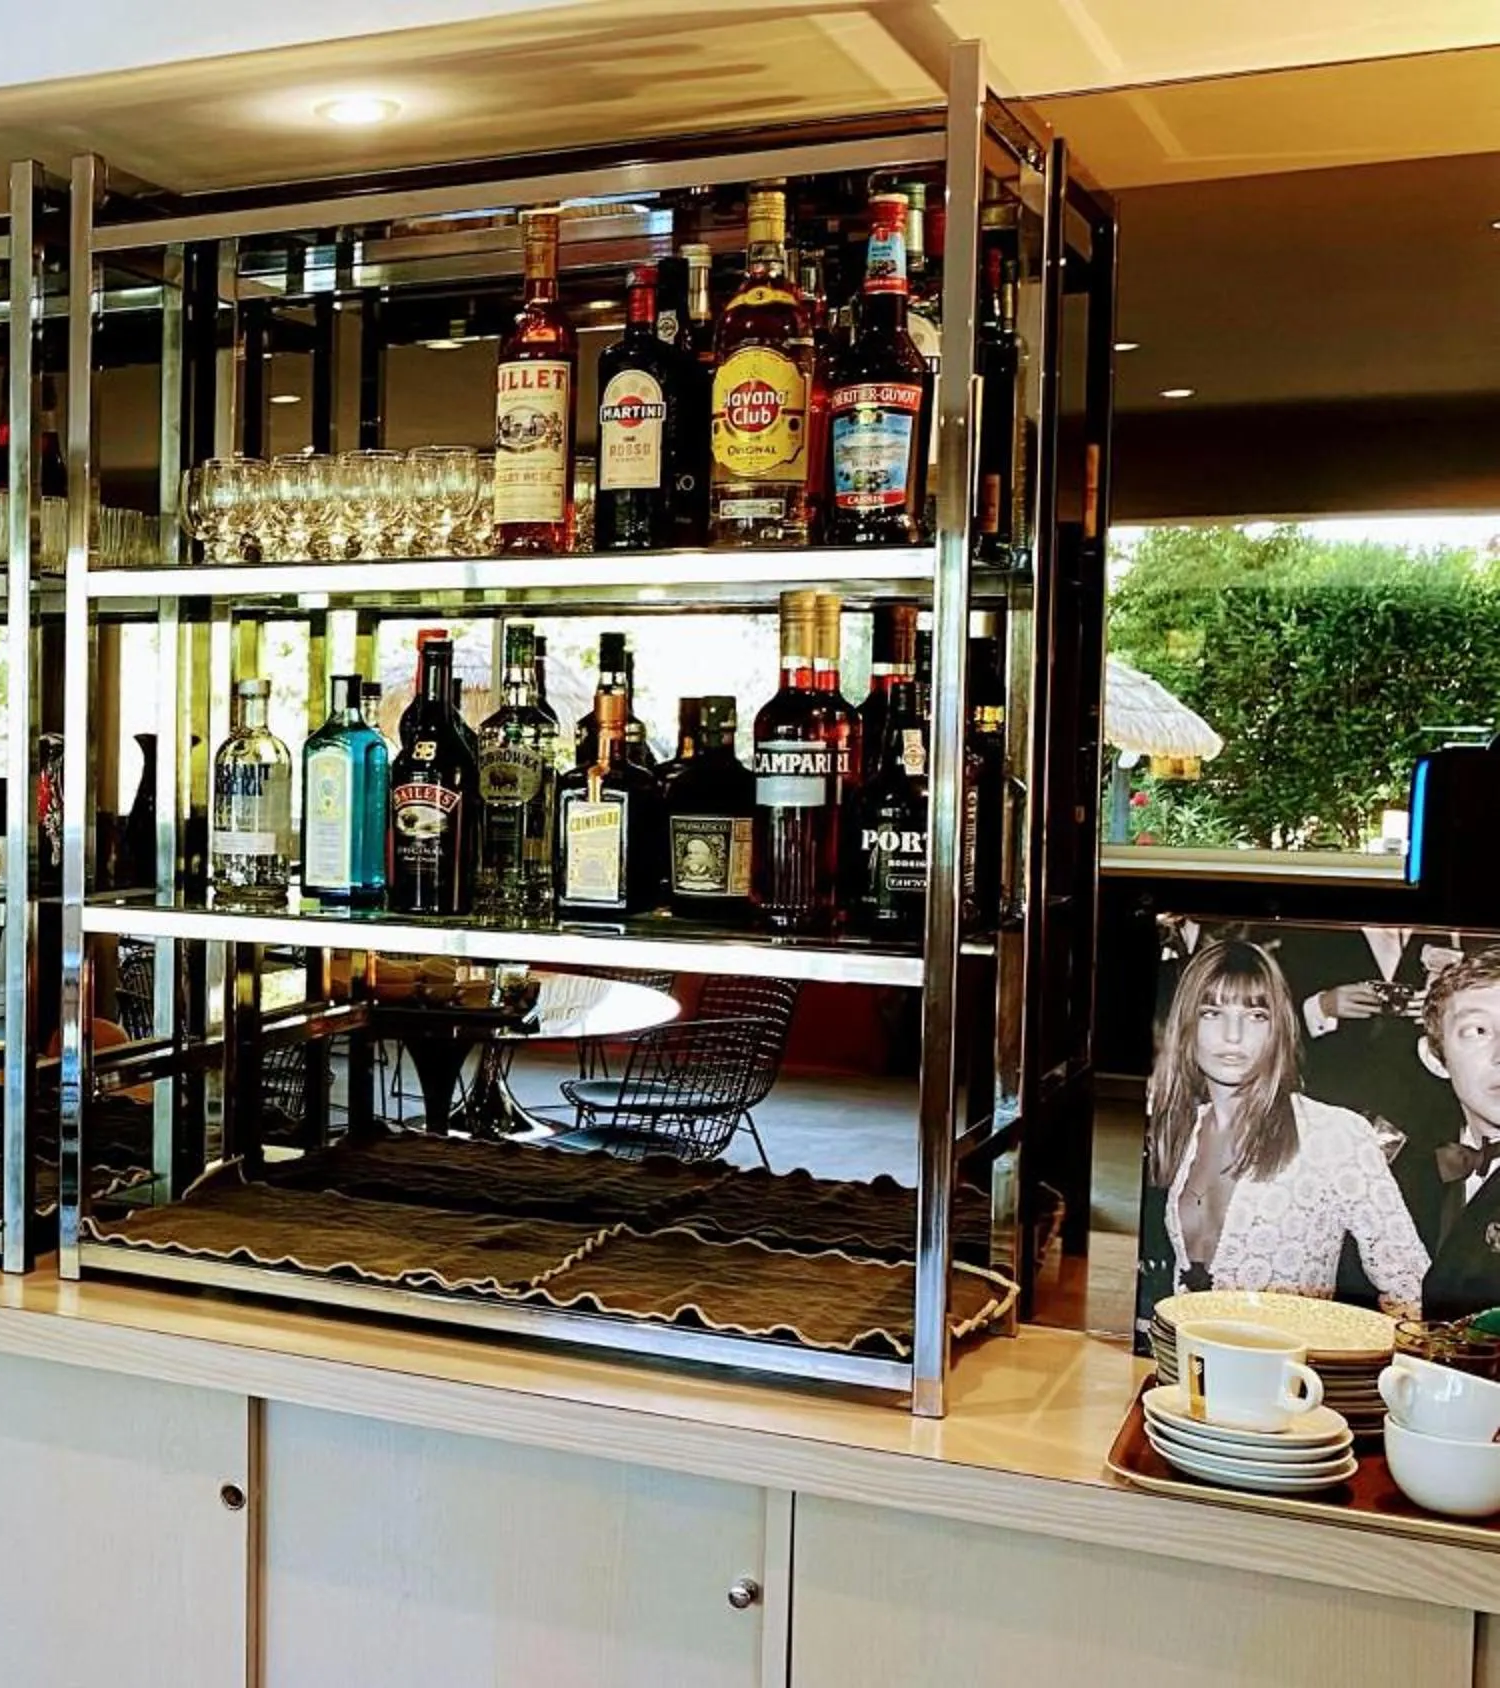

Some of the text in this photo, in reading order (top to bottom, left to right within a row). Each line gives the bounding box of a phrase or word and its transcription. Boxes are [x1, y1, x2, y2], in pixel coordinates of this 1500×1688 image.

[498, 369, 565, 393] ILLET
[603, 405, 662, 420] MARTINI
[732, 407, 772, 425] Club
[754, 753, 831, 773] CAMPARI
